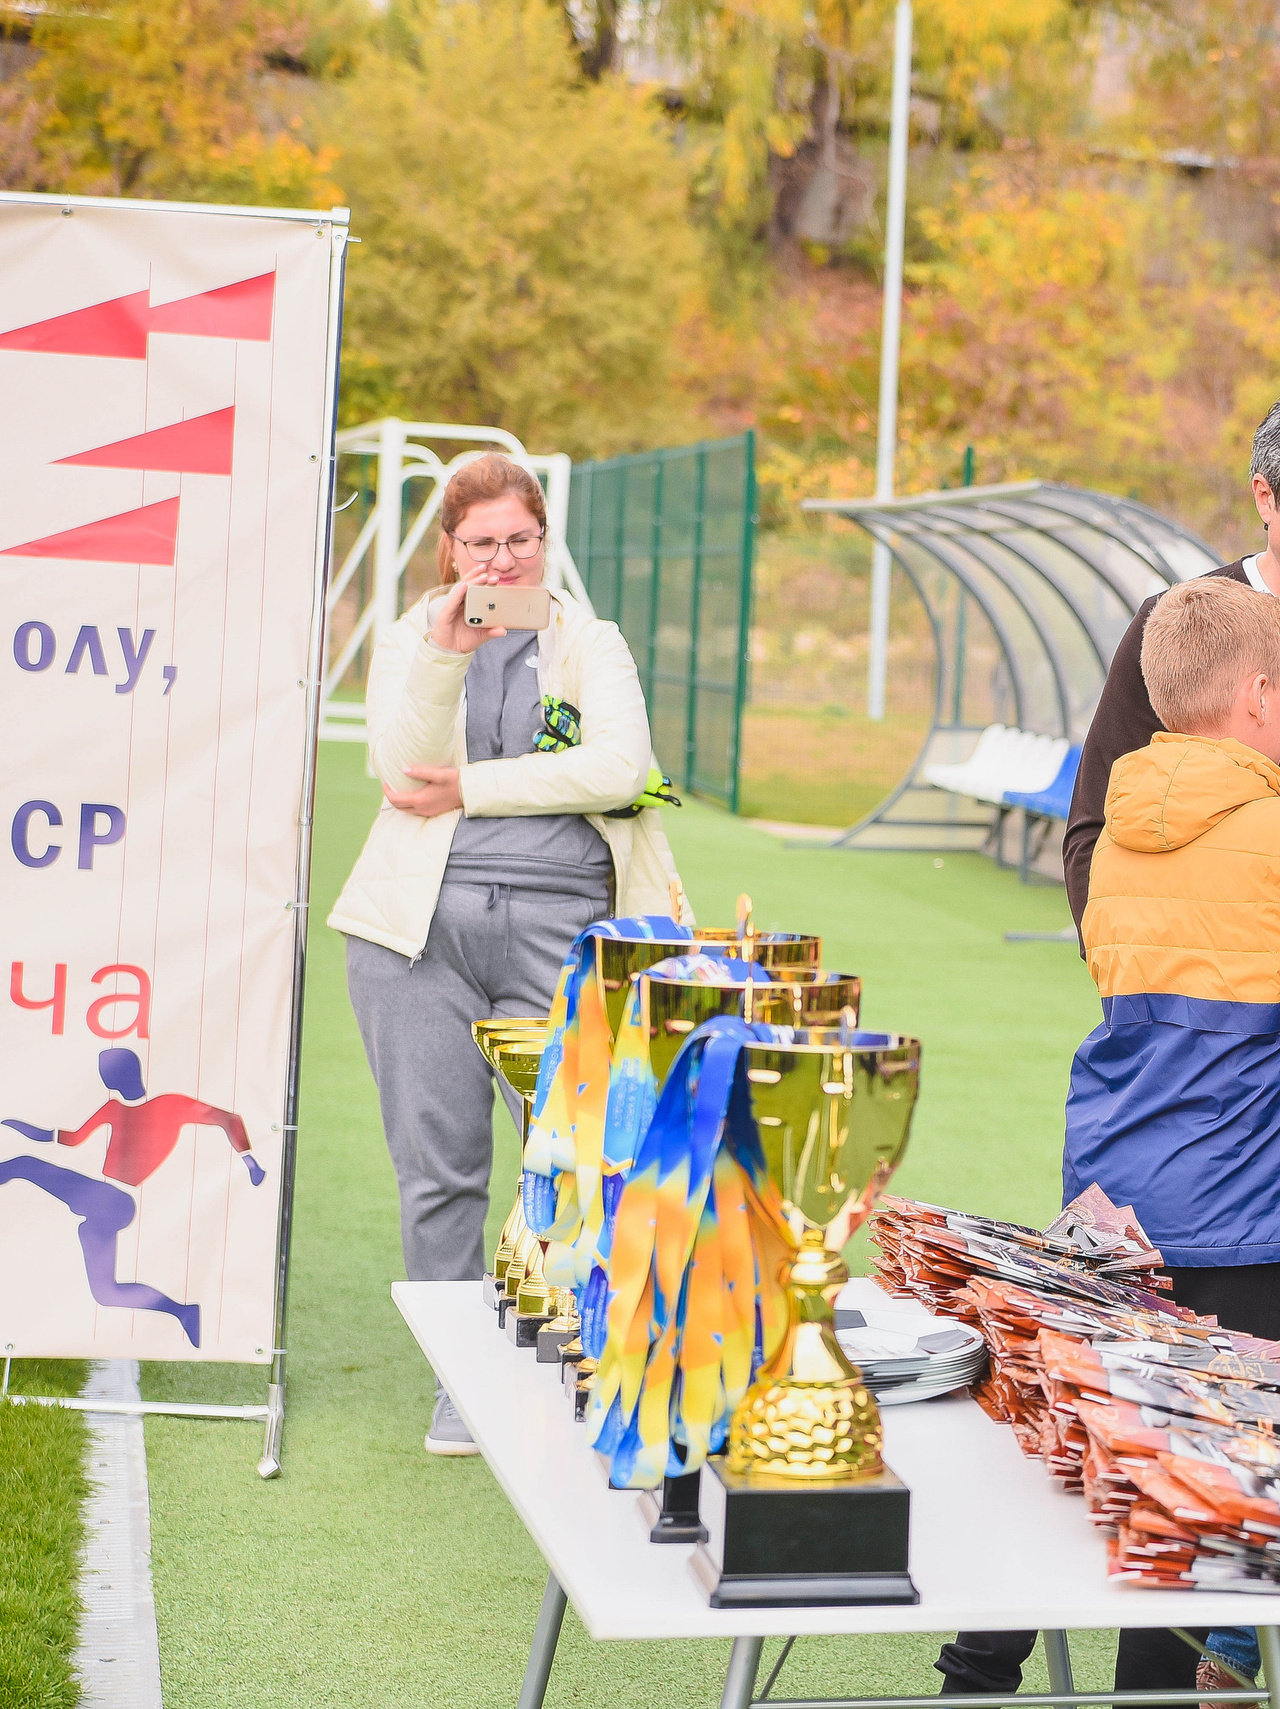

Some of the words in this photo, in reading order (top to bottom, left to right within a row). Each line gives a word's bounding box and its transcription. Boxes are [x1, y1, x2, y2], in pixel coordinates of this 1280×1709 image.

[13, 620, 179, 696] олу,
[11, 799, 127, 870] СР
[10, 961, 152, 1040] ча
